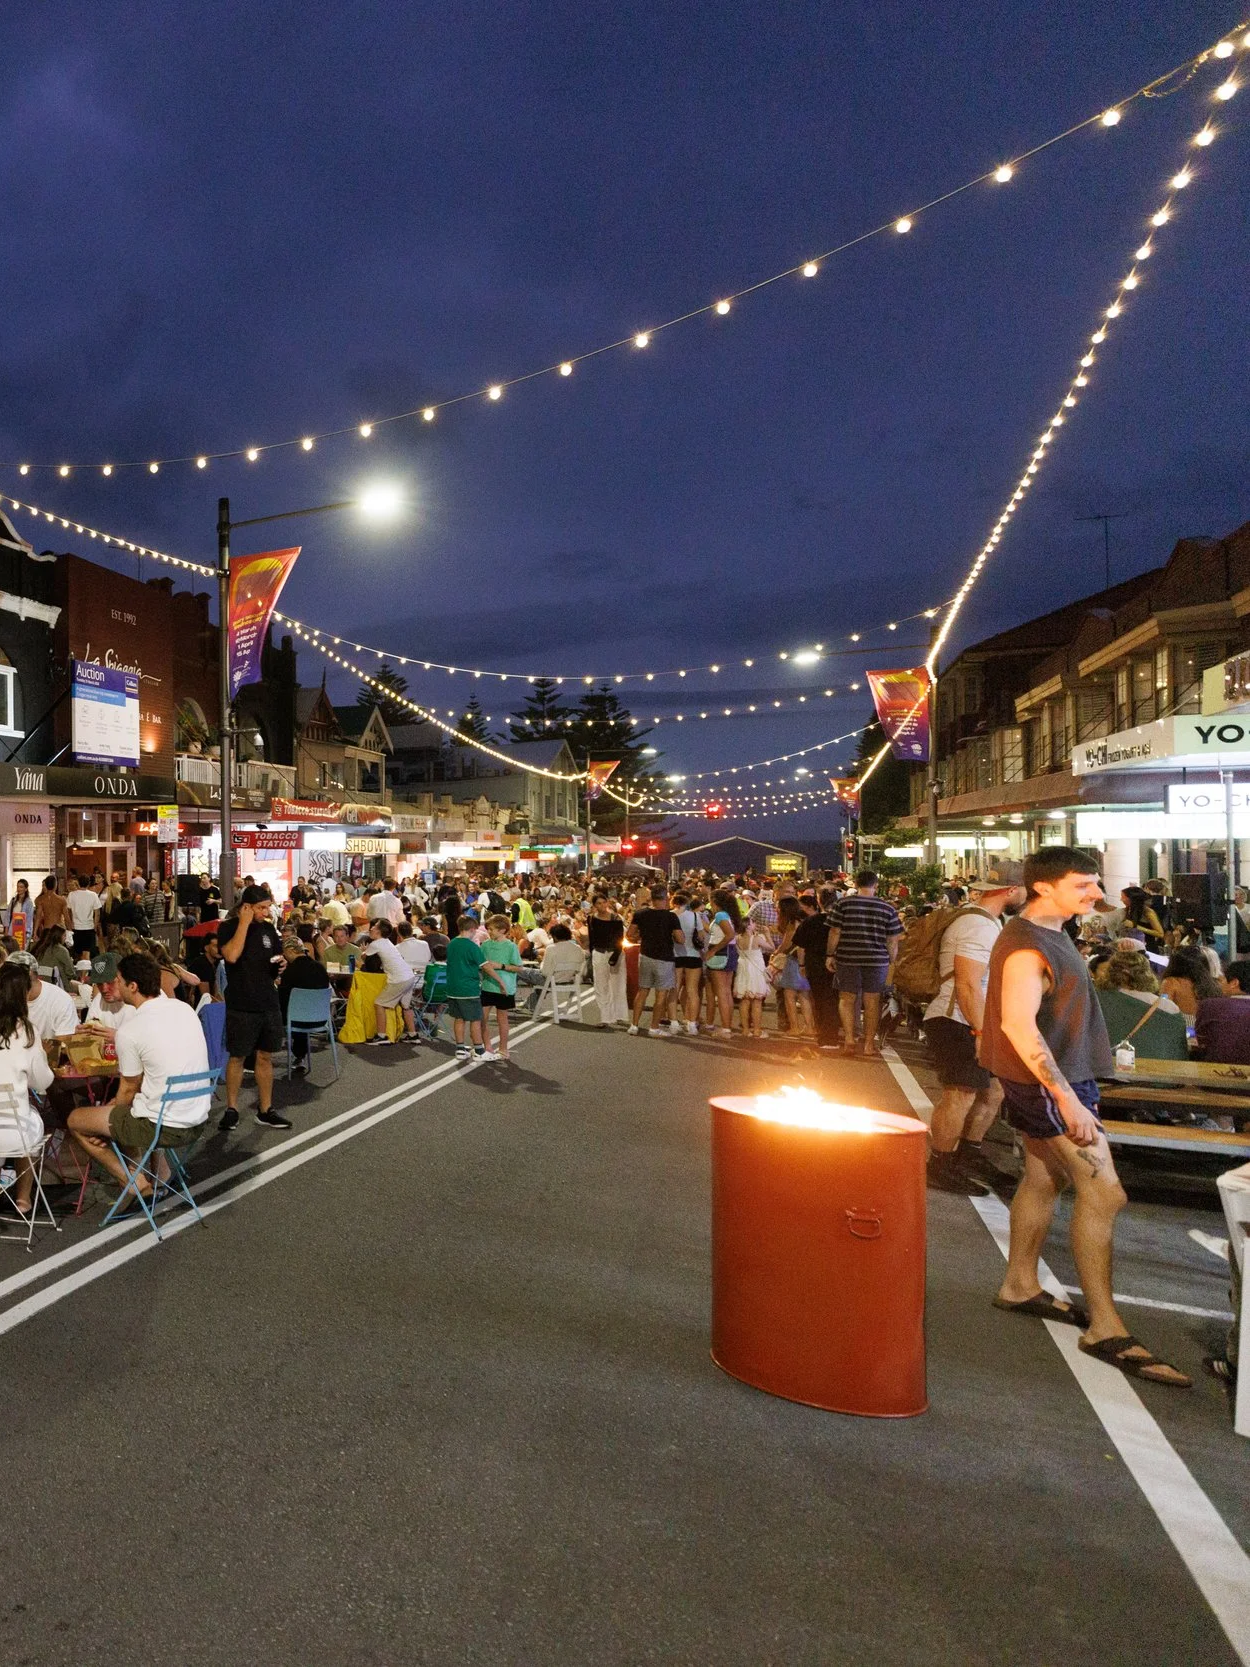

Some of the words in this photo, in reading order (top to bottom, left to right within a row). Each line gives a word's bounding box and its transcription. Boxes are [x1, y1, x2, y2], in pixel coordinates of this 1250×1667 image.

[123, 612, 137, 626] 1992
[76, 664, 105, 682] Auction
[1194, 724, 1250, 745] YO
[14, 766, 44, 791] Yana
[94, 776, 138, 796] ONDA
[15, 814, 42, 824] ONDA
[254, 832, 299, 841] TOBACCO
[256, 840, 297, 848] STATION
[347, 839, 390, 853] SHBOWL
